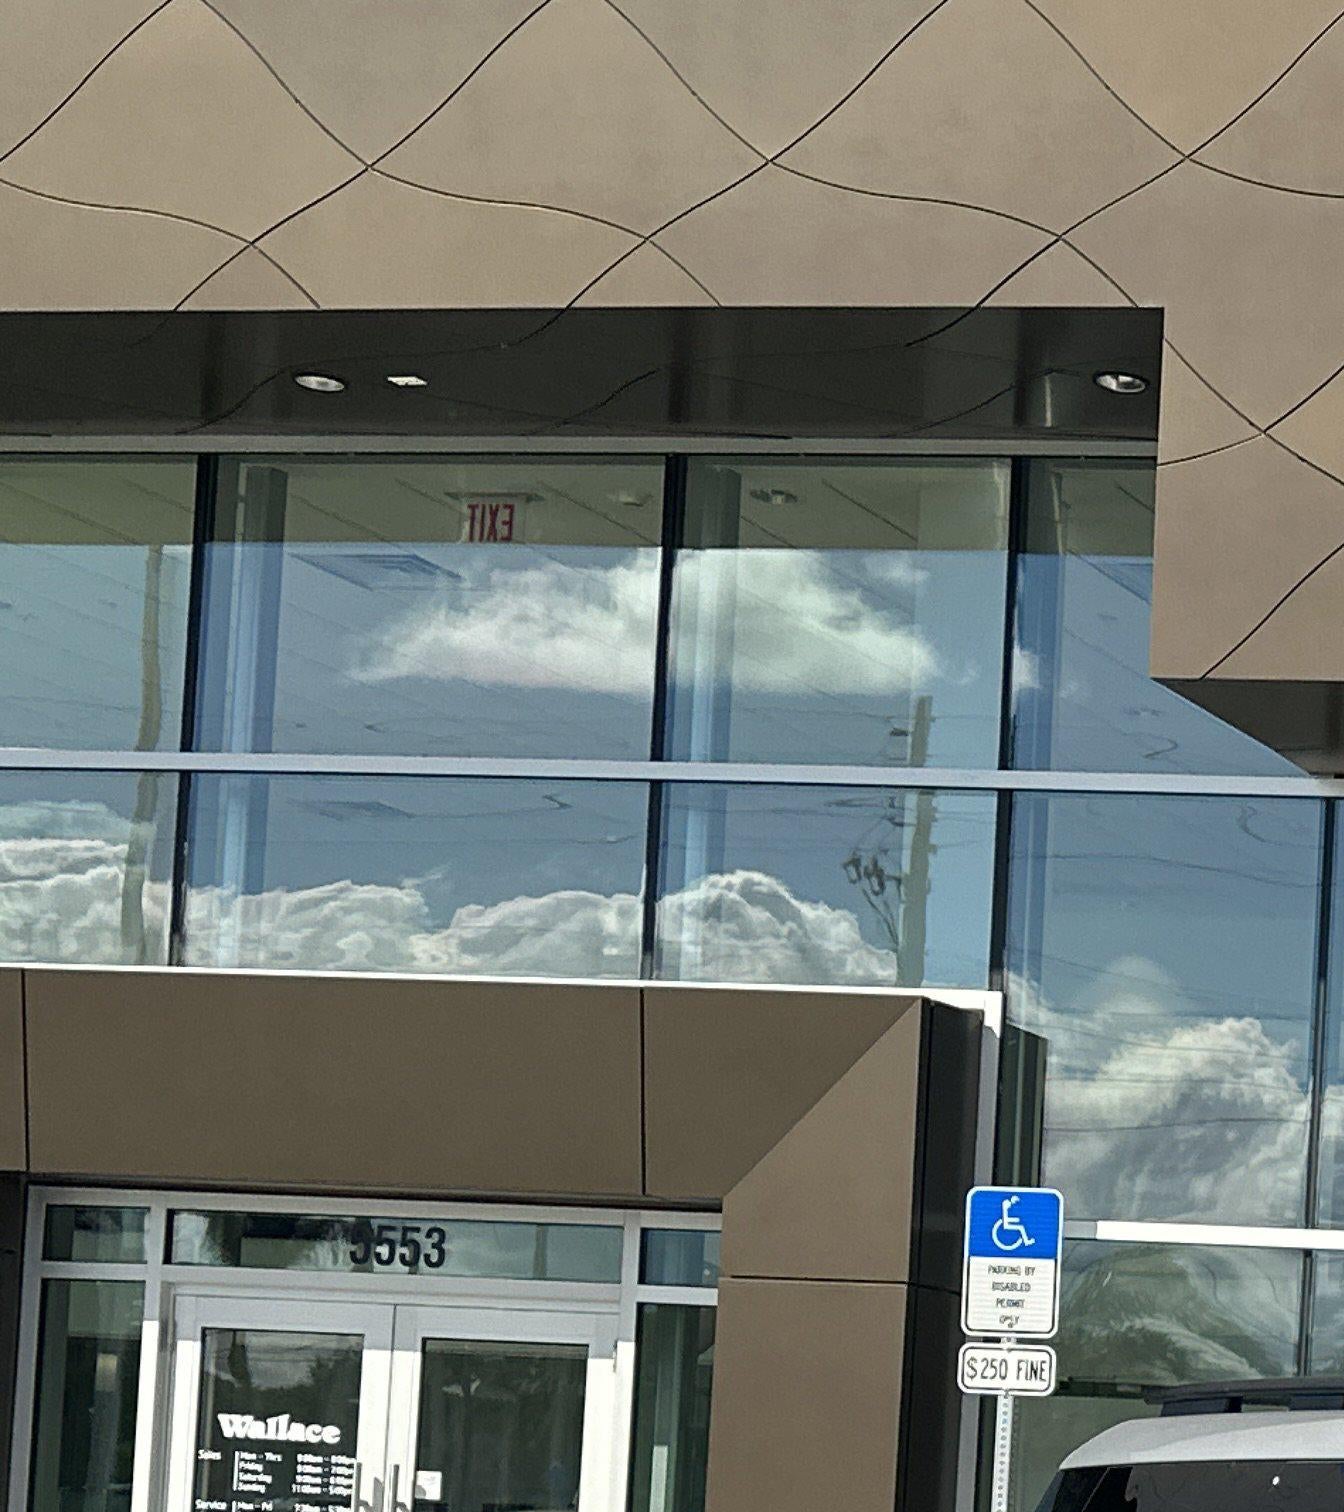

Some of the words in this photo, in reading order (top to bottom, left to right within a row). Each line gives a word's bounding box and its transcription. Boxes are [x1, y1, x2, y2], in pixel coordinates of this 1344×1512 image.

[987, 1265, 1021, 1276] PARKING
[1024, 1266, 1036, 1277] BY
[992, 1281, 1031, 1292] DISABLED
[996, 1298, 1025, 1309] PERMIT
[966, 1356, 1008, 1381] $250
[1016, 1359, 1047, 1382] FINE
[217, 1413, 341, 1444] Wallace
